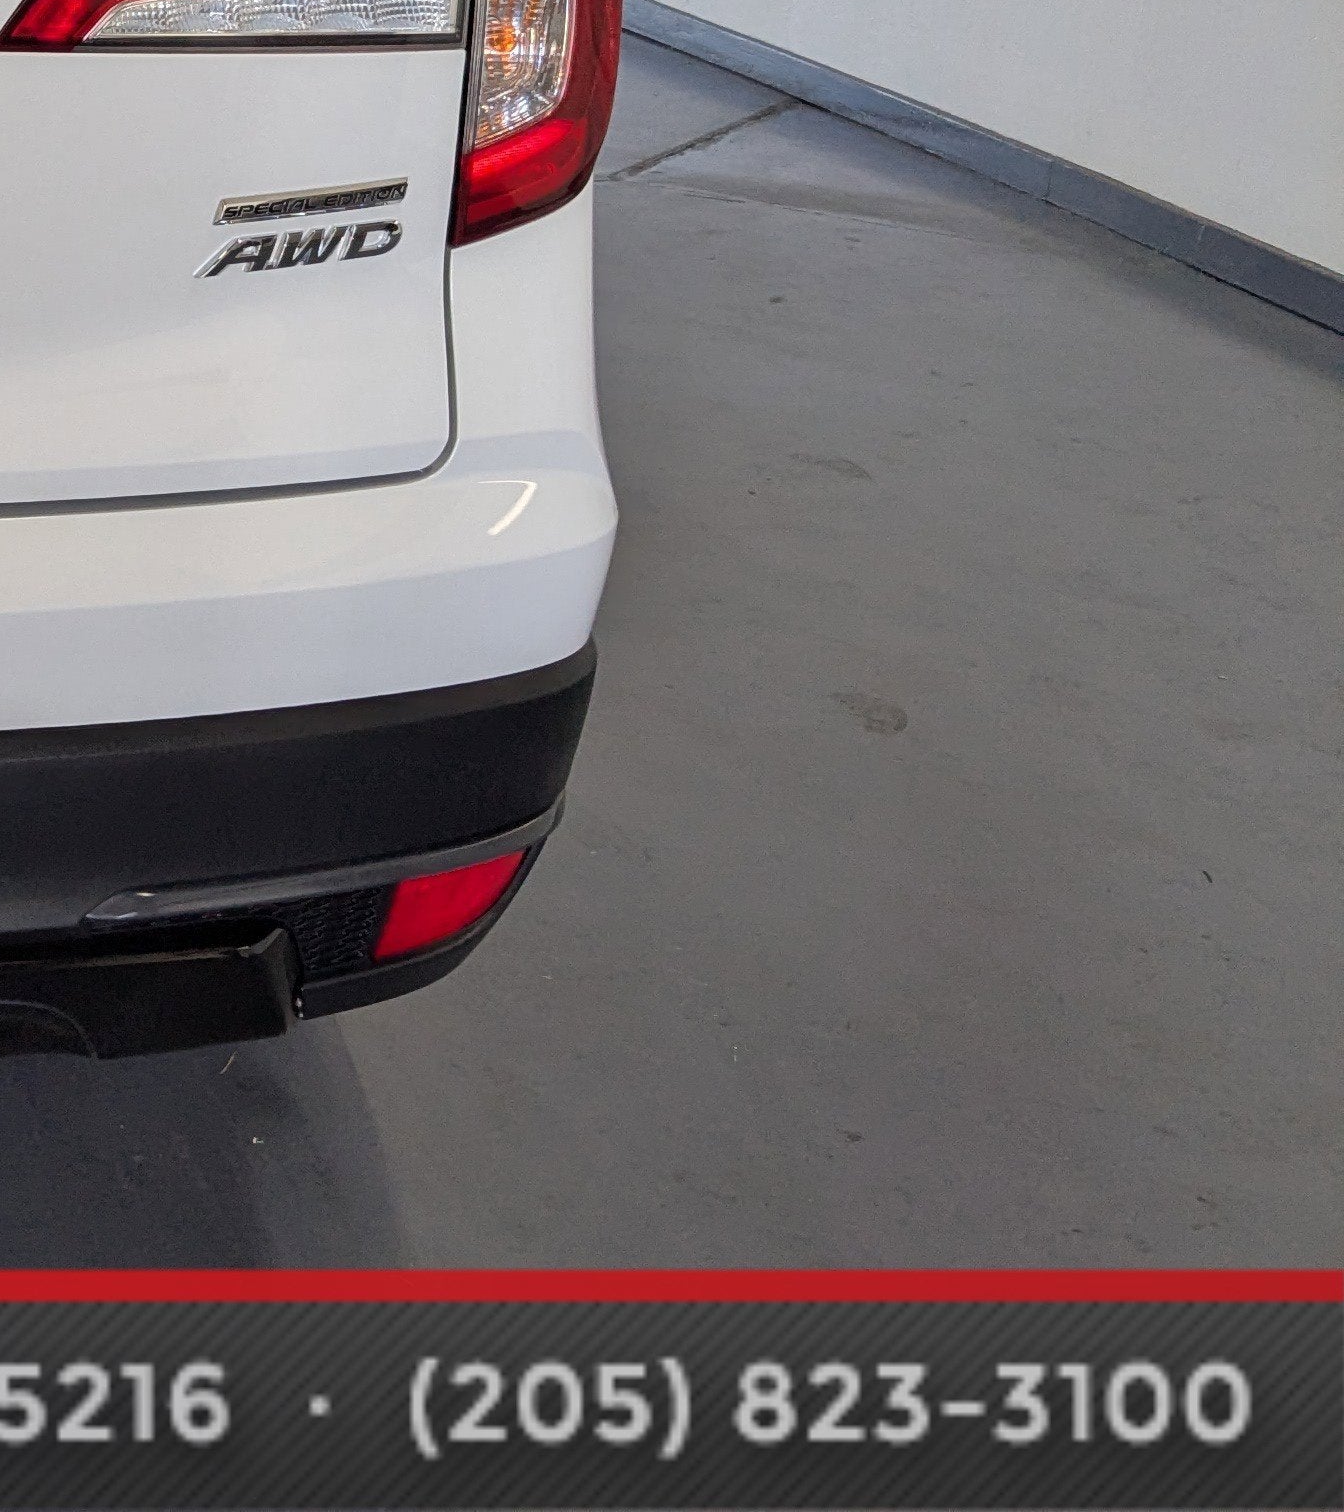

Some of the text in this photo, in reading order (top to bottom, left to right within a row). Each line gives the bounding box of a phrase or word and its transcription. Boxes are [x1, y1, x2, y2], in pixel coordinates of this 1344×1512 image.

[223, 181, 408, 218] SPECIAL EDITION
[193, 219, 403, 278] AWD
